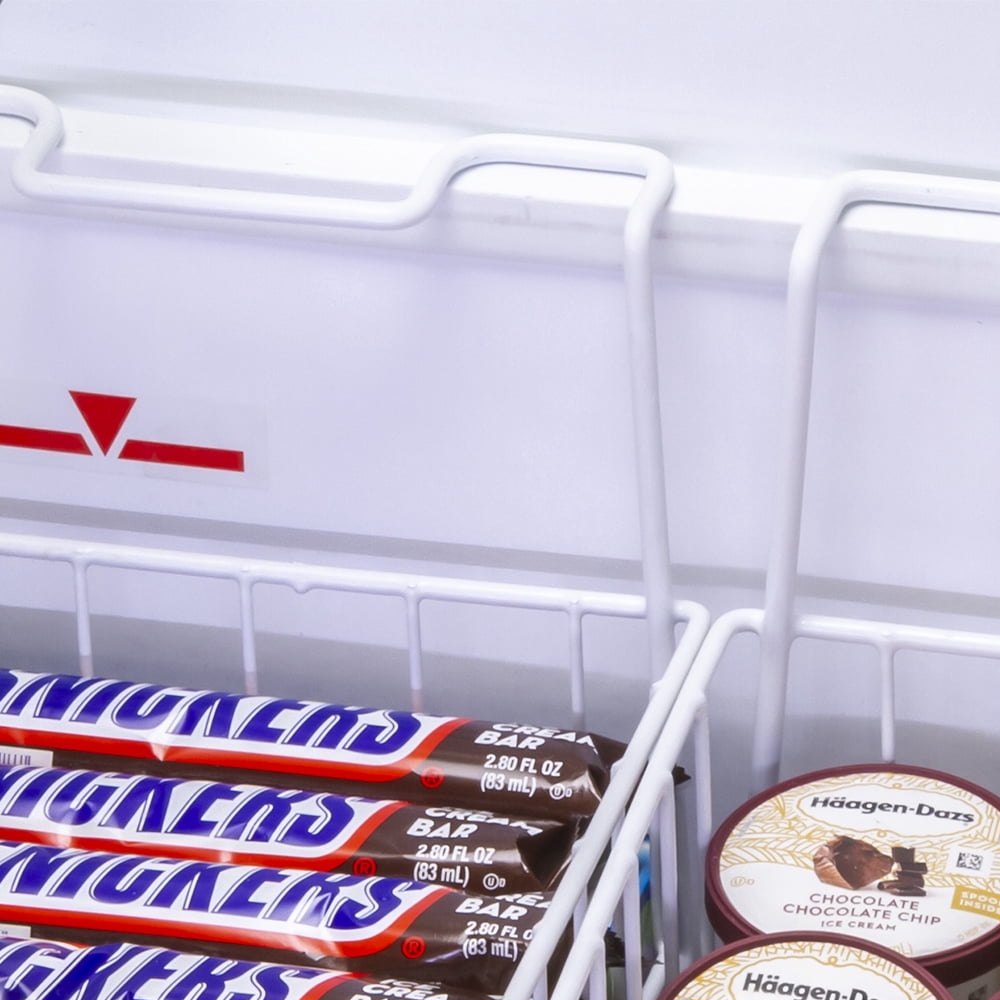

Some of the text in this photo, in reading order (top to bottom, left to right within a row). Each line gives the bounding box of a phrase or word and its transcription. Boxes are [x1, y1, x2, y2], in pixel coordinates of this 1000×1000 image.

[474, 730, 546, 750] BAR
[483, 754, 565, 778] 2.80 FL OZ
[480, 773, 538, 798] (83 mL)
[809, 796, 976, 825] Häagen-Dazs
[406, 818, 478, 839] BAR
[415, 844, 496, 865] 2.80 FL OZ
[413, 861, 470, 889] (83 mL)
[455, 898, 528, 920] BAR
[808, 893, 920, 912] CHOCOLATE
[782, 903, 942, 926] CHOCOLATE CHIP
[464, 921, 519, 939] 2.80 FL
[820, 920, 898, 932] ICE CREAM
[463, 938, 519, 962] (83 mL)
